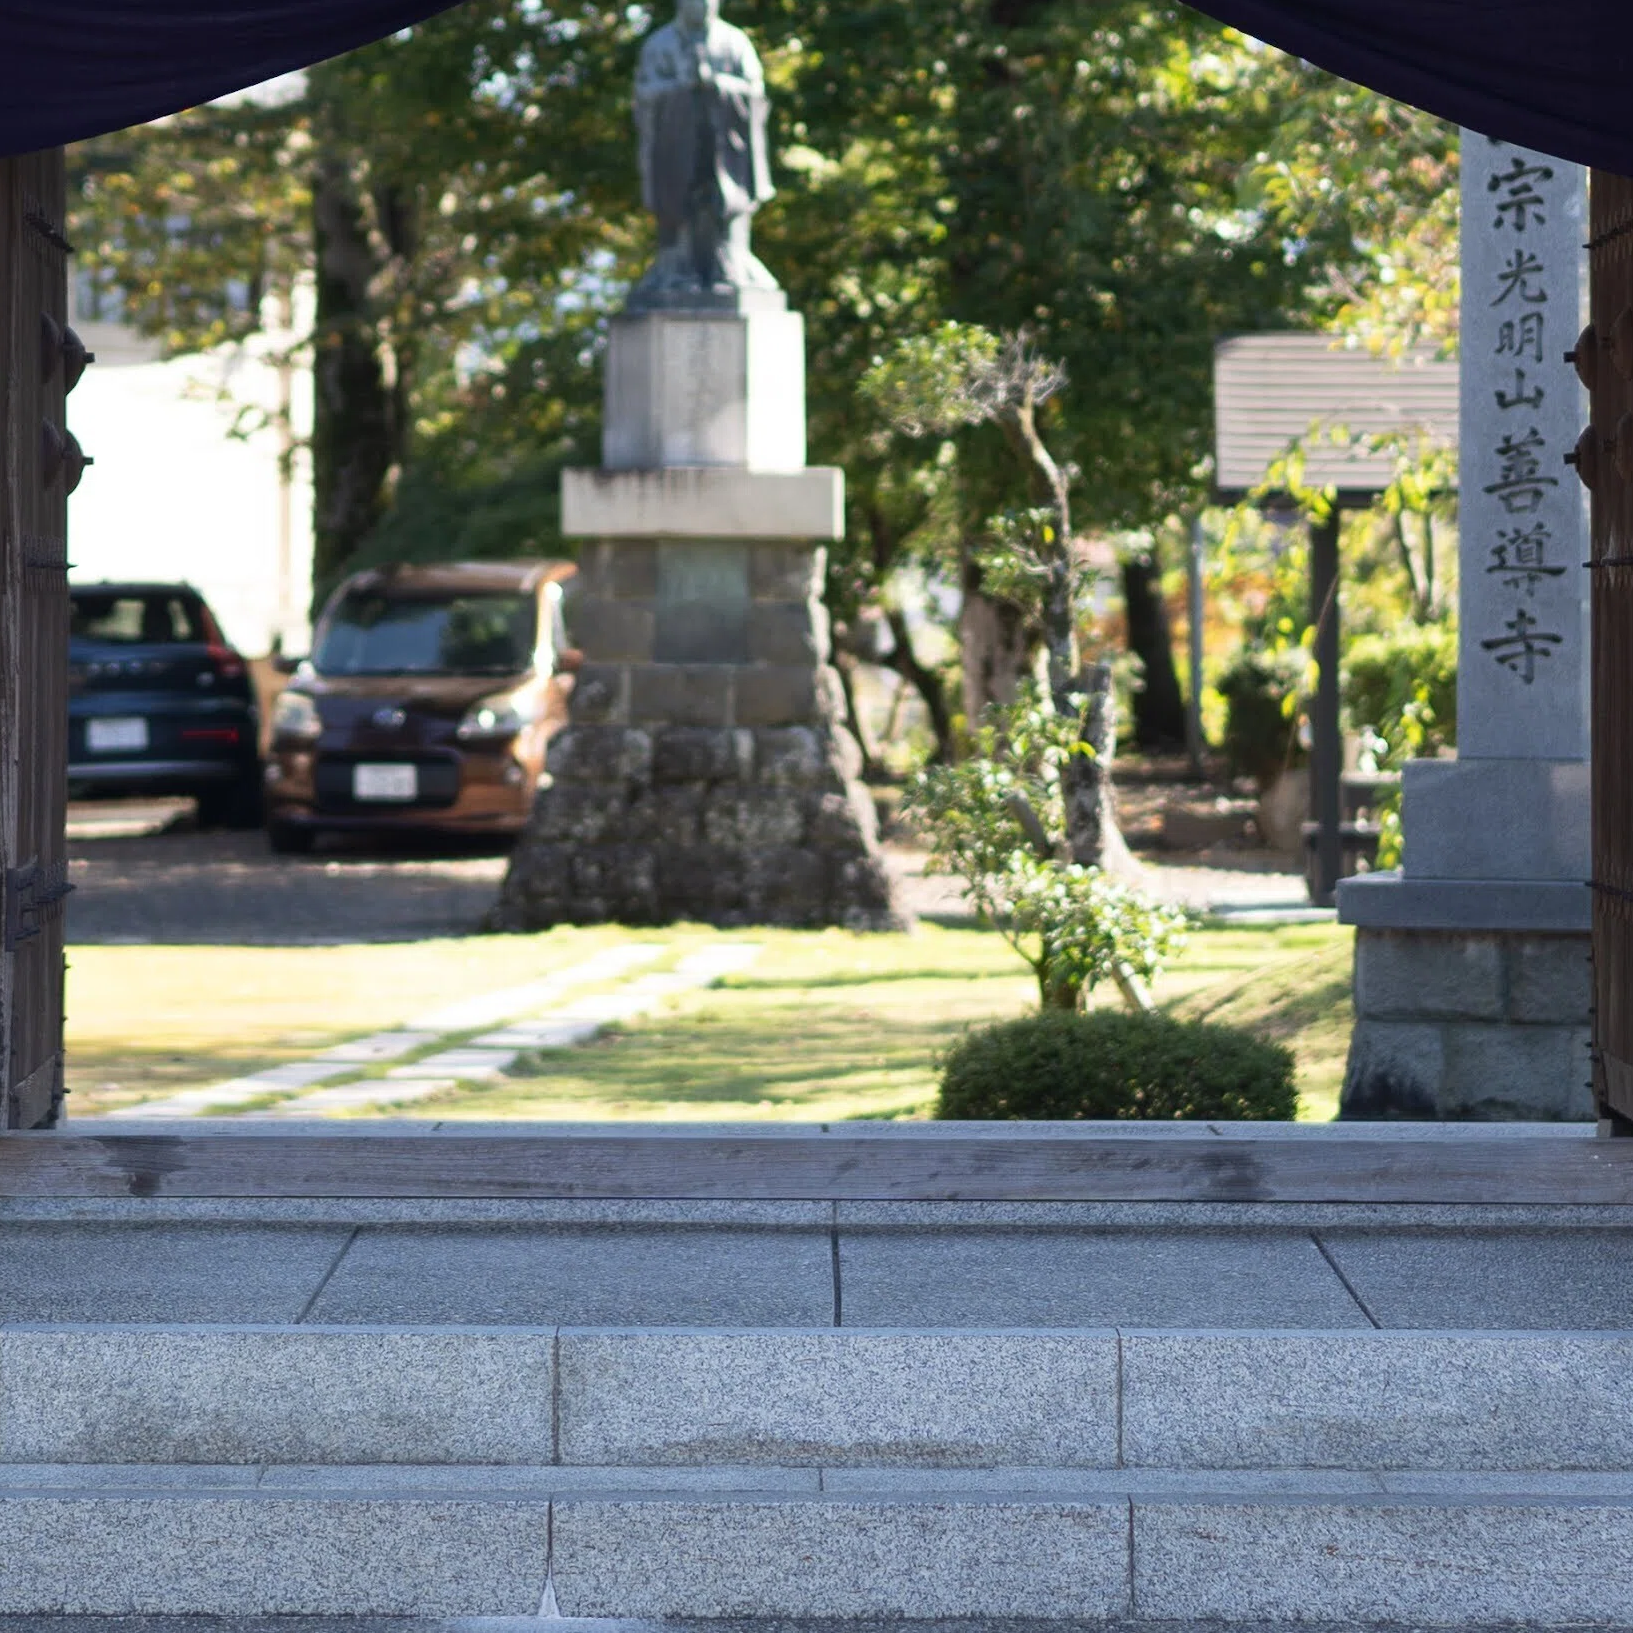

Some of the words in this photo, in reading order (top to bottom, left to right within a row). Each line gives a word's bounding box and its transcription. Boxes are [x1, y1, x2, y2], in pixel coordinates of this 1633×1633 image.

[1479, 135, 1567, 686] 宗光明山善導寺
